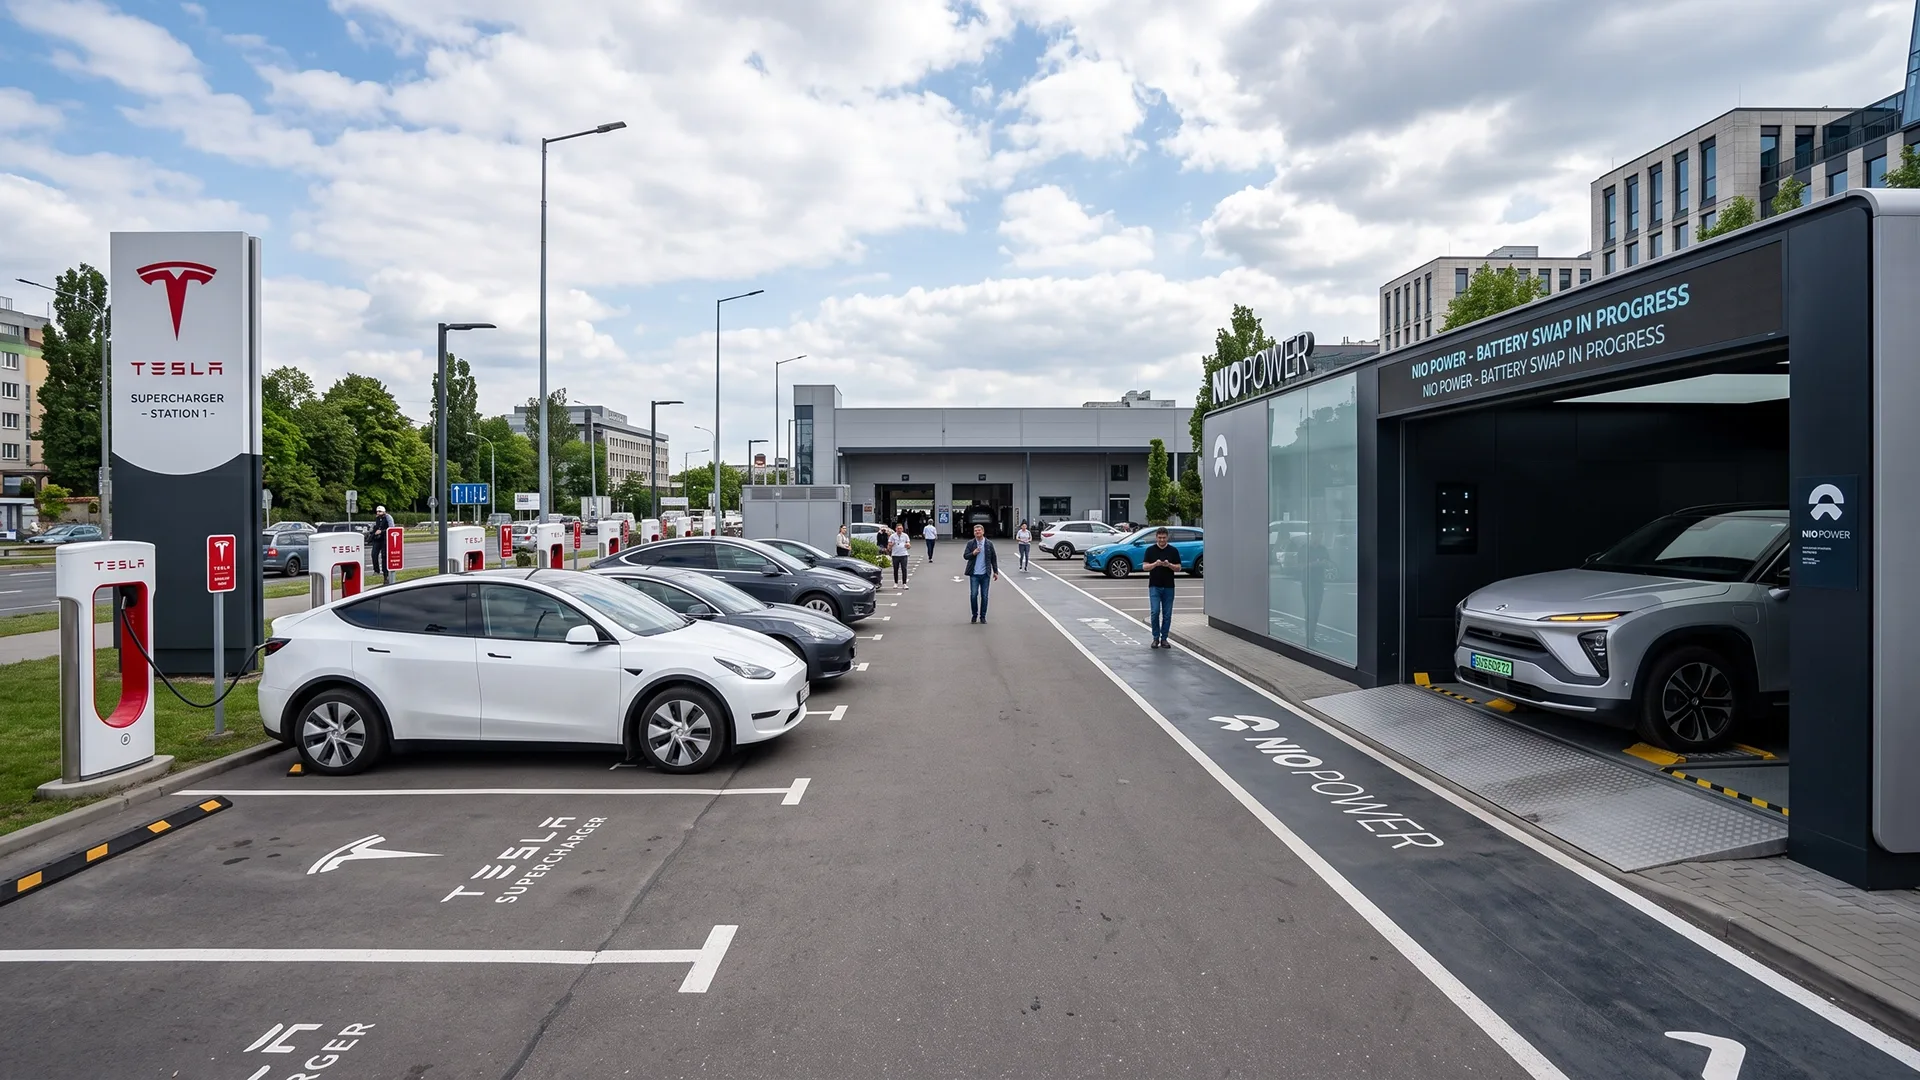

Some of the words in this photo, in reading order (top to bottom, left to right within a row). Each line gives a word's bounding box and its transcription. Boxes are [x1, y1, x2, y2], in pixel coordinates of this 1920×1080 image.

[1412, 362, 1428, 379] NIO
[1430, 350, 1466, 374] POWER
[1477, 331, 1529, 361] BATTERY
[1532, 319, 1572, 347] SWAP
[1576, 312, 1592, 335] IN
[1596, 283, 1690, 329] PROGRESS
[1423, 382, 1438, 397] NIO
[1440, 373, 1473, 393] POWER
[1481, 358, 1528, 385] BATTERY
[1530, 350, 1565, 374] SWAP
[1568, 345, 1582, 365] IN
[1586, 324, 1665, 361] PROGRESS
[130, 361, 223, 376] TESLA
[130, 393, 225, 403] SUPERCHARGER
[150, 408, 200, 418] STATION
[202, 408, 208, 418] 1
[331, 545, 360, 554] TESLA
[94, 558, 145, 571] TESLA
[440, 816, 577, 903] TESLA
[495, 817, 608, 903] SUPERCHARGER
